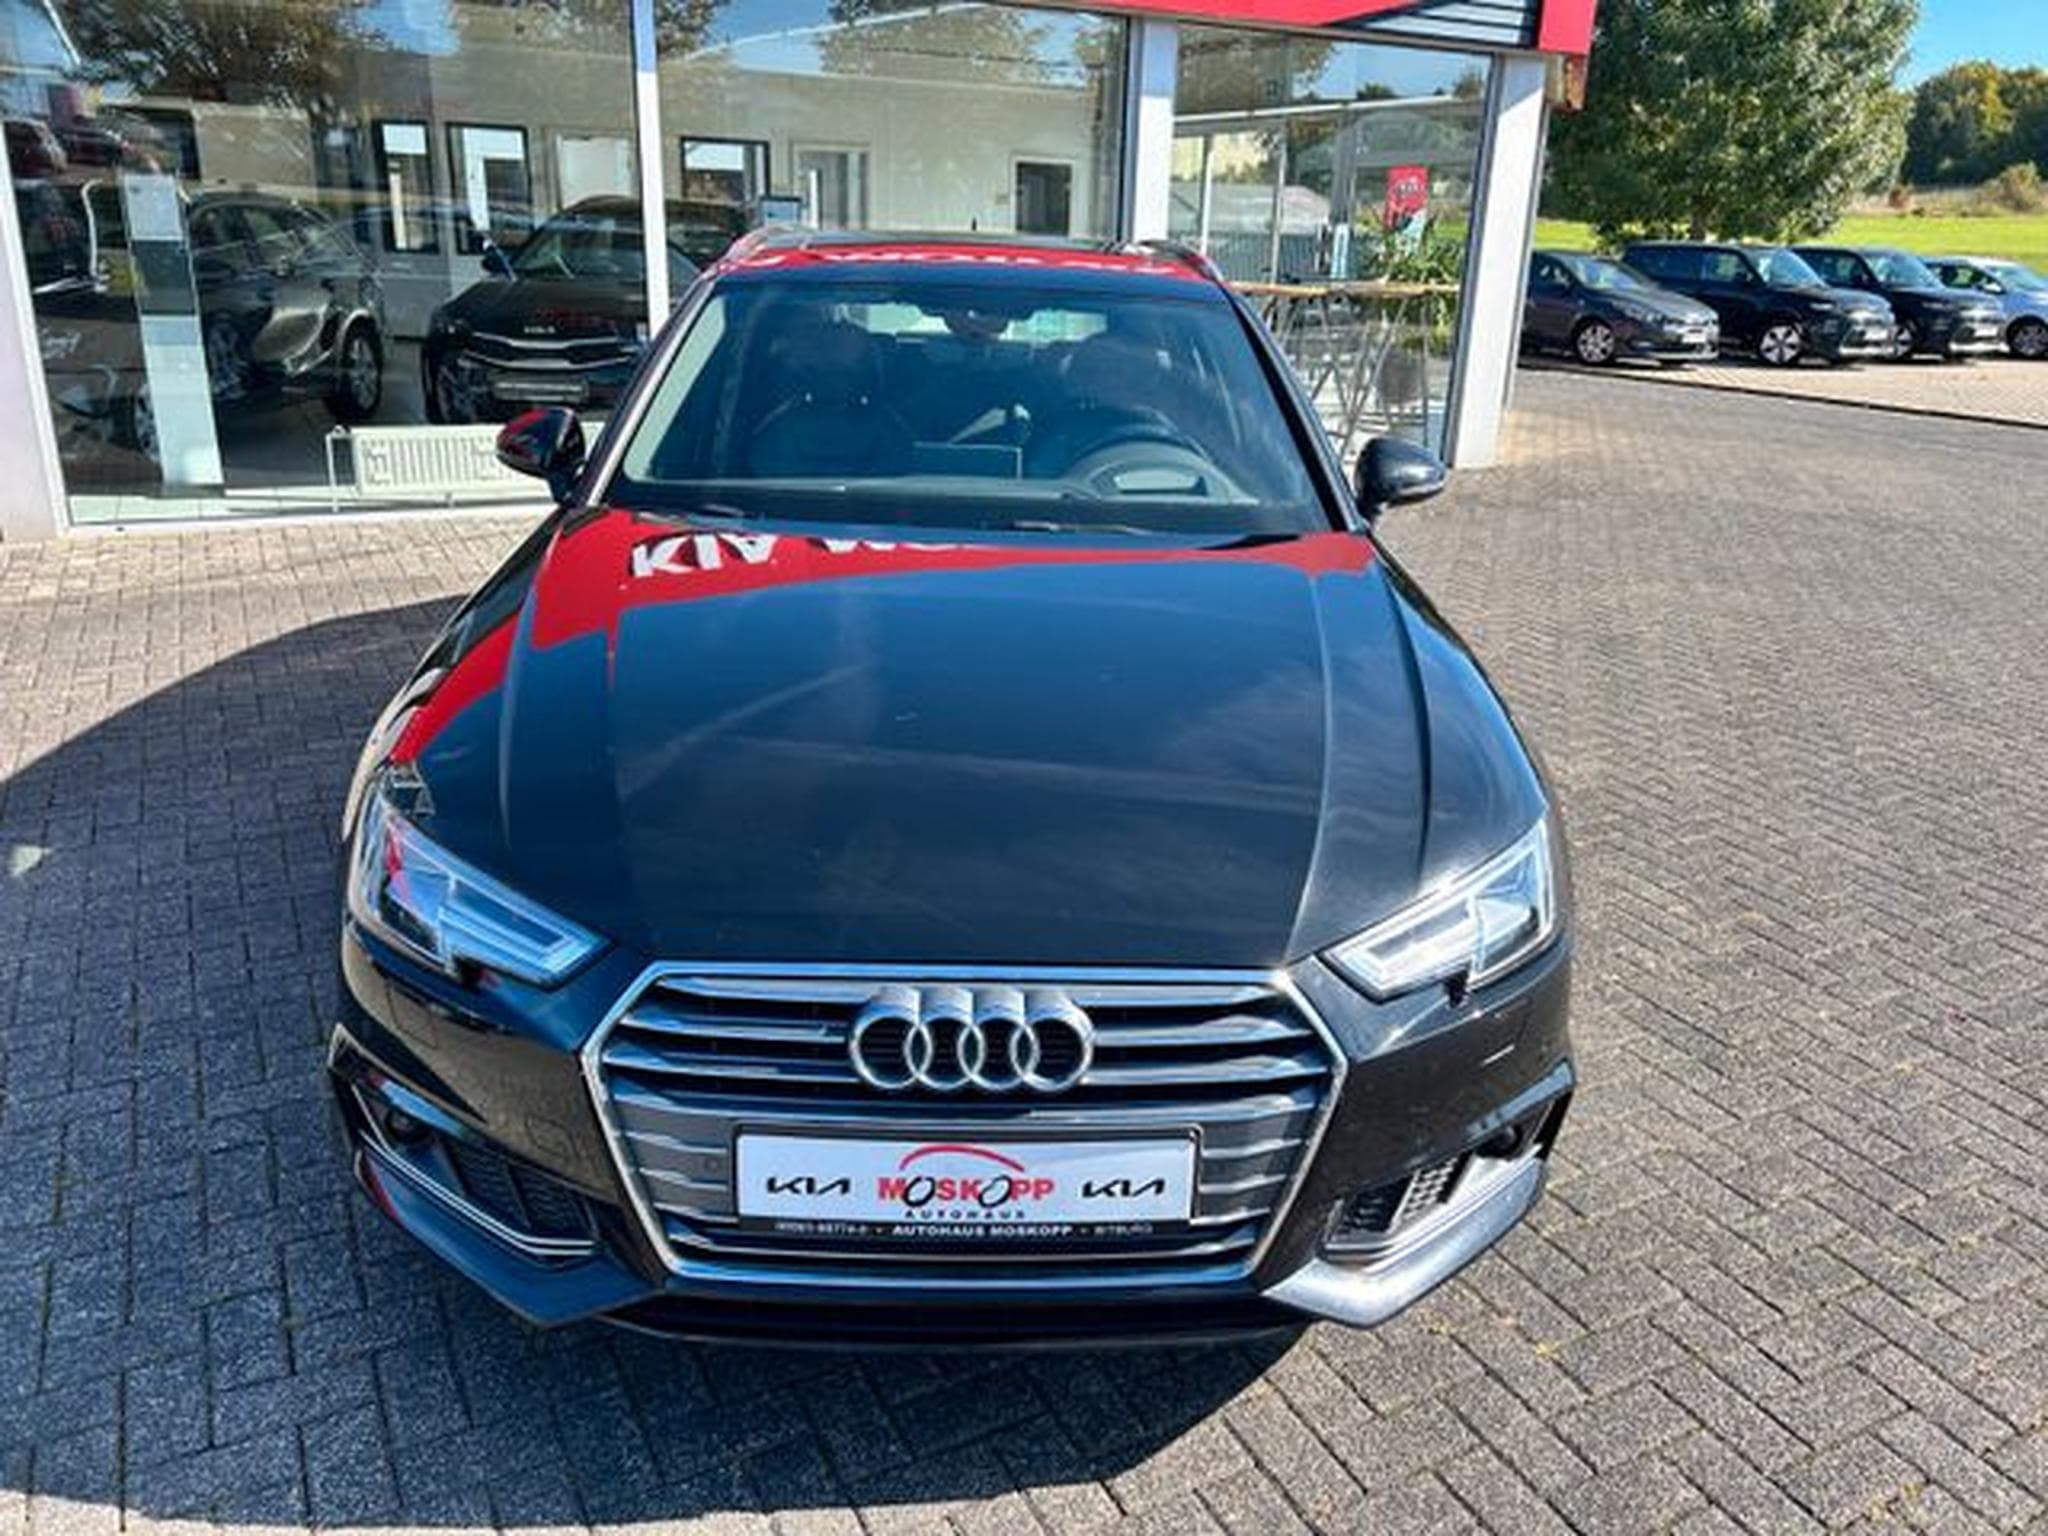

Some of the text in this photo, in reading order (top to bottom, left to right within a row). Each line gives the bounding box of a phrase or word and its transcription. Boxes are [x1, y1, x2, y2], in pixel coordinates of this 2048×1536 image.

[767, 1174, 1166, 1207] KIA MOSKOPP KIA
[905, 1210, 1025, 1220] AUTOHAUS
[892, 1225, 985, 1236] AUTOHAUS
[989, 1225, 1073, 1237] MOSKOPP
